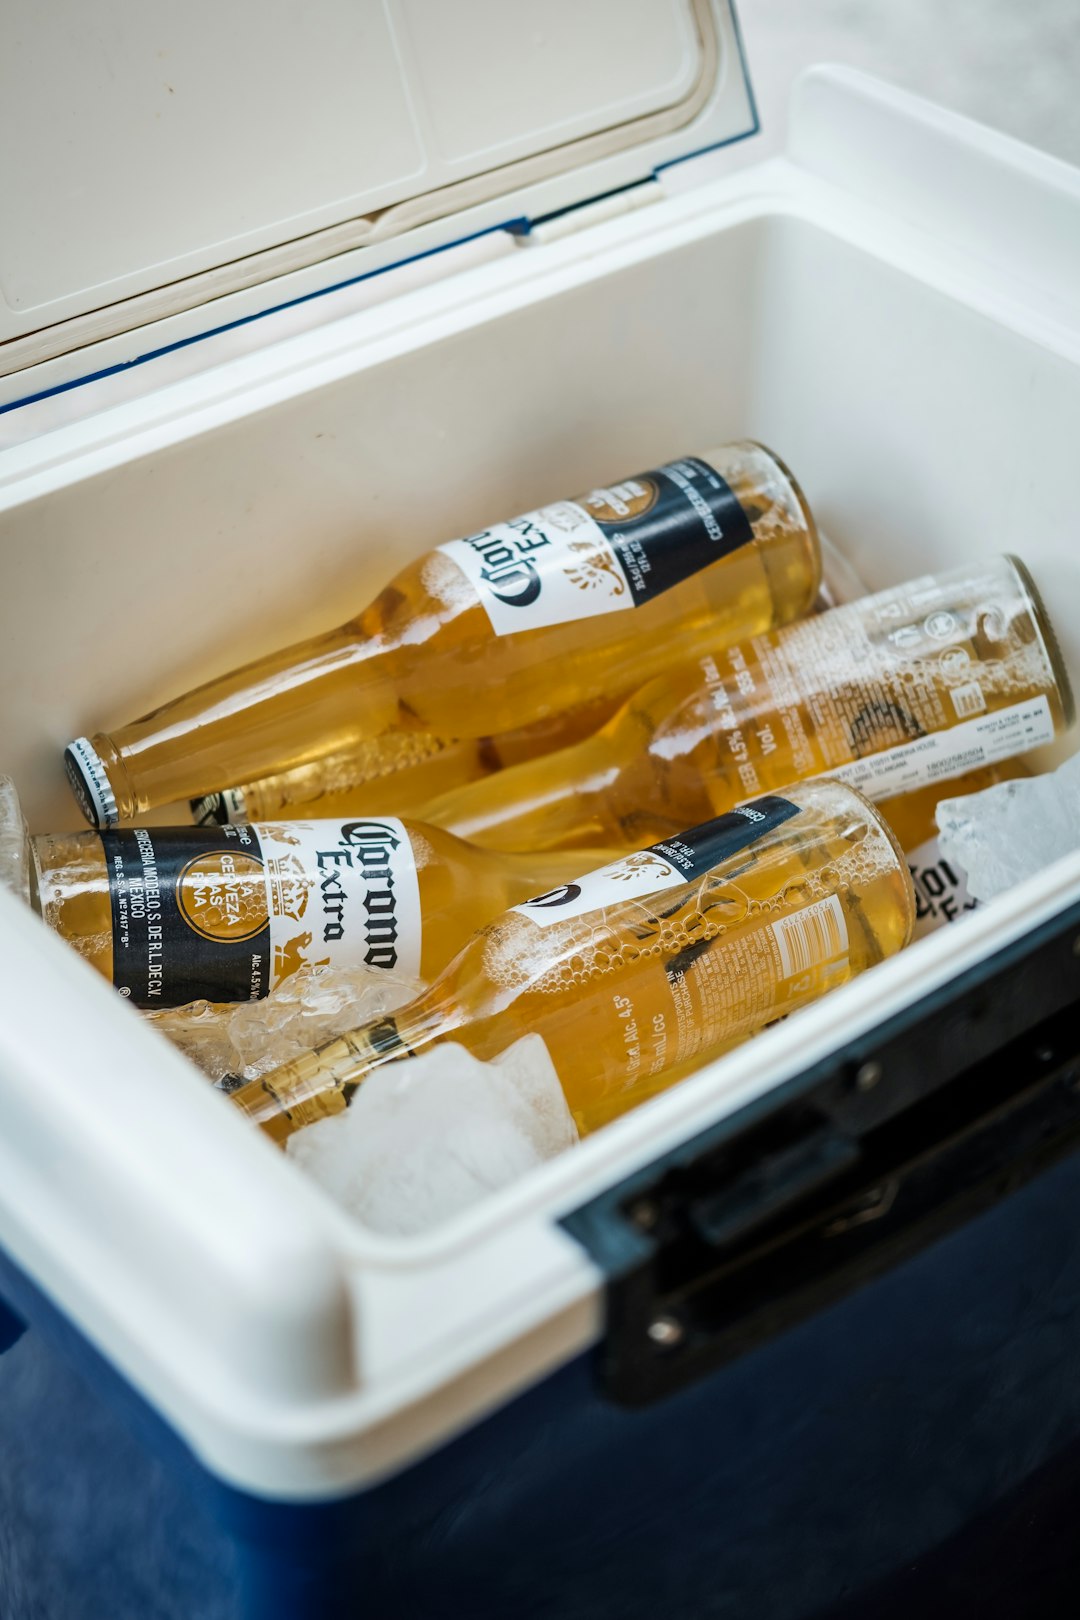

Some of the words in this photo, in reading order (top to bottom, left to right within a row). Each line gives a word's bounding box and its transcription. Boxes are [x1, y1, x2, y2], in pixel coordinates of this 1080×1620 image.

[756, 723, 777, 756] Vol.
[133, 829, 156, 866] CERVECERIA
[128, 878, 146, 919] MEXICO
[144, 865, 162, 912] MODELO,
[220, 855, 240, 926] CERVEZA
[316, 849, 354, 943] Extra
[338, 822, 401, 969] Corona
[148, 925, 162, 941] DE
[251, 954, 262, 970] Alc.
[251, 970, 262, 989] 4.5%
[666, 970, 676, 982] IN
[147, 980, 162, 998] C.V.
[674, 970, 694, 1018] PURCHASE
[624, 1018, 640, 1043] Alc.
[652, 1013, 667, 1057] mL/cc
